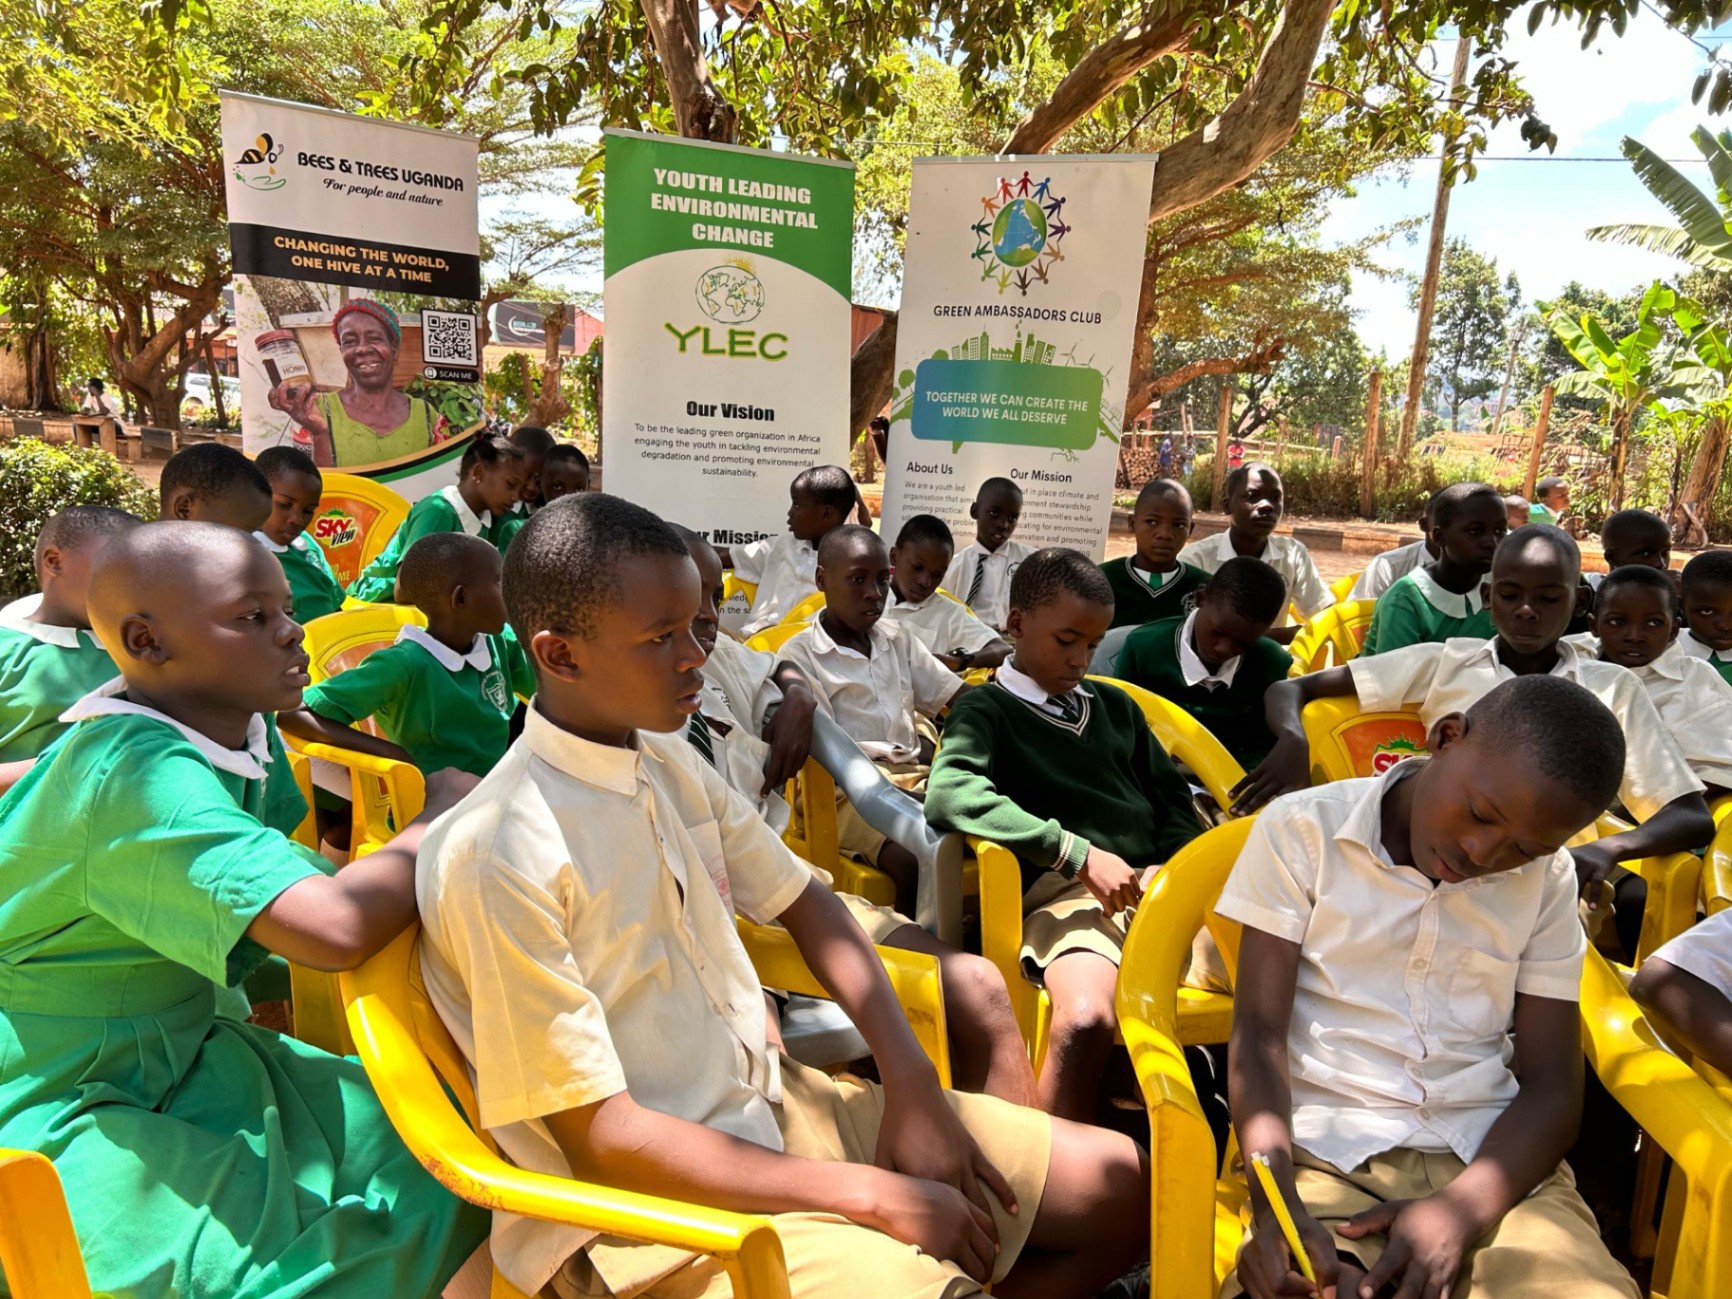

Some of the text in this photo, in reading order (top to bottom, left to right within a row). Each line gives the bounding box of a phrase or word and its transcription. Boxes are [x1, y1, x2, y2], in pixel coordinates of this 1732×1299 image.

[297, 152, 464, 191] BEES & TREES UGANDA
[323, 177, 444, 207] For people and nature
[653, 168, 811, 204] YOUTH LEADING
[651, 192, 818, 229] ENVIRONMENTAL
[691, 223, 774, 248] CHANGE
[274, 236, 450, 272] CHANGING THE WORLD,
[291, 255, 432, 283] ONE HIVE AT A TIME
[933, 305, 1102, 324] GREEN AMBASSADORS CLUB
[664, 322, 788, 361] YLEC
[439, 370, 473, 380] SCAN ME
[926, 391, 1088, 412] TOGETHER WE CAN CREATE THE
[686, 401, 775, 421] Our Vision
[942, 406, 1067, 425] WORLD WE ALL DESERVE
[634, 423, 821, 443] To be the leading green organization in Africa
[634, 438, 673, 448] engaging
[675, 439, 690, 447] the
[692, 441, 716, 449] youth
[729, 443, 761, 453] tackling
[763, 445, 821, 455] environmental
[640, 450, 814, 467] degradation and promoting environmental
[702, 468, 758, 478] sustainability.
[906, 461, 953, 475] About Us
[1010, 468, 1073, 483] Our Mission
[904, 481, 916, 489] We
[934, 483, 953, 492] youth
[954, 483, 966, 492] led
[1037, 488, 1057, 497] place
[1058, 490, 1085, 499] climate
[1085, 492, 1099, 500] and
[903, 493, 944, 501] organisation
[945, 494, 958, 503] that
[902, 504, 964, 514] providing practical
[1048, 502, 1092, 512] stewardship
[1028, 512, 1072, 521] communities
[1073, 514, 1093, 522] while
[315, 518, 353, 538] SKY
[1041, 523, 1052, 531] for
[1053, 525, 1103, 535] environmental
[713, 529, 778, 545] Missio
[1060, 536, 1097, 547] promoting
[727, 606, 741, 614] the
